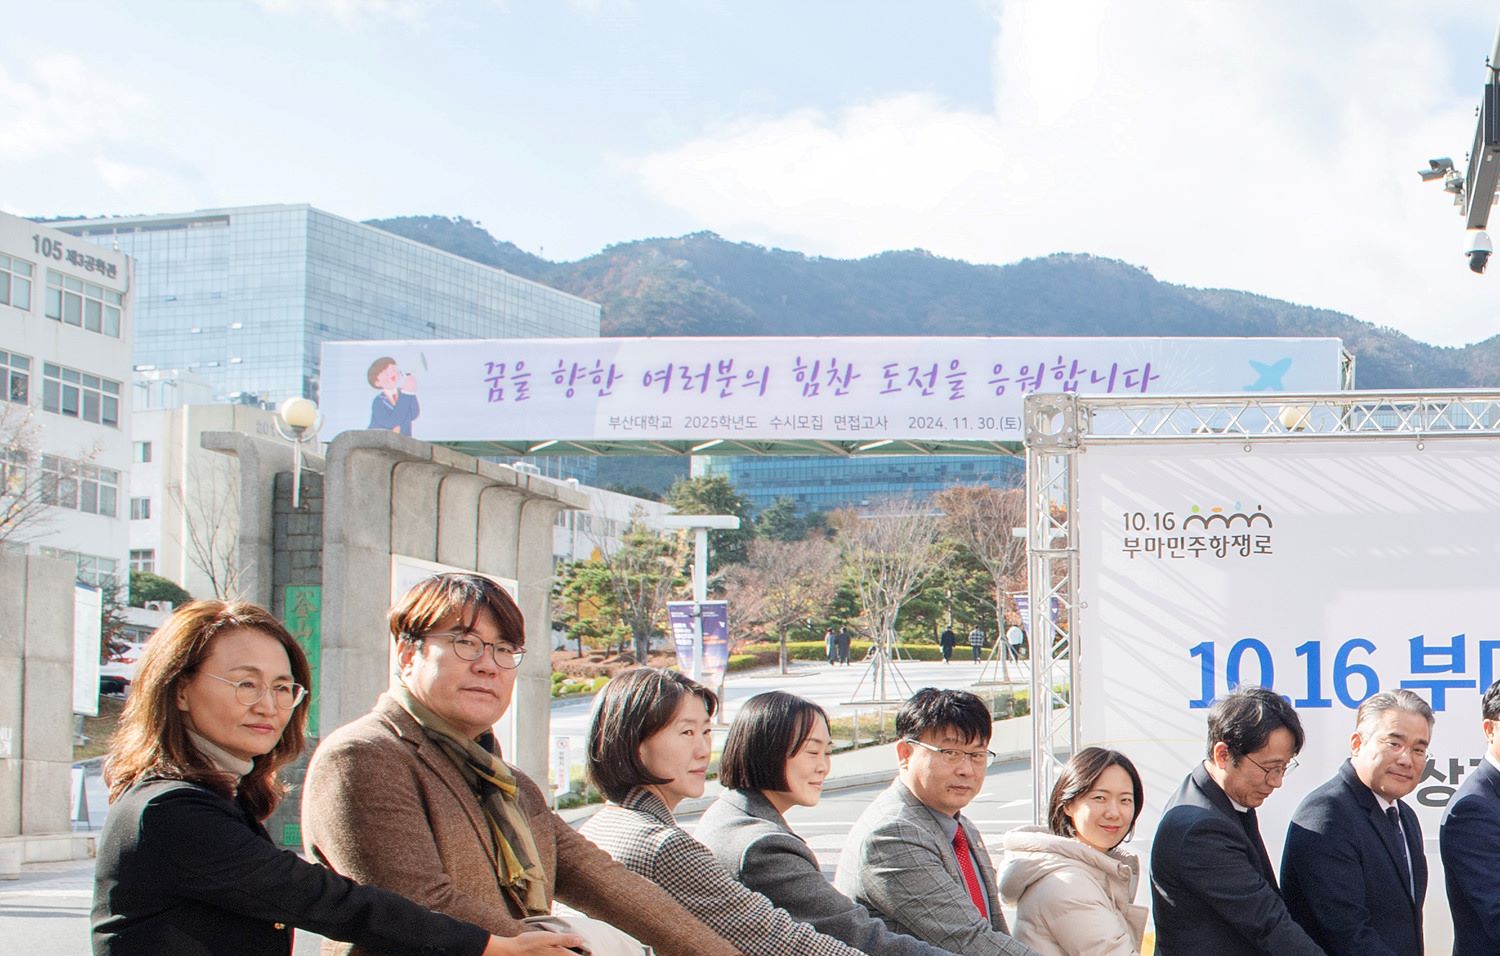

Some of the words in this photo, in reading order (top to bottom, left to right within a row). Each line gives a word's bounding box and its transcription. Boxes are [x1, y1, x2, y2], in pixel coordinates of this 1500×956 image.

[32, 234, 62, 260] 105
[483, 360, 531, 402] 꿈을
[551, 359, 624, 398] 향한
[643, 358, 770, 398] 여러분의
[791, 355, 861, 397] 힘찬
[879, 359, 967, 400] 도전을
[987, 355, 1160, 393] 응원합니다
[608, 415, 673, 431] 부산대학교
[684, 415, 758, 431] 2025학년도
[769, 415, 823, 431] 수시모집
[834, 415, 888, 431] 면접고사
[908, 417, 945, 431] 2024.
[953, 417, 973, 431] 11.
[977, 416, 1023, 432] 30.(토)
[1122, 512, 1175, 531] 10.16
[1122, 534, 1273, 559] 부마민주항쟁로
